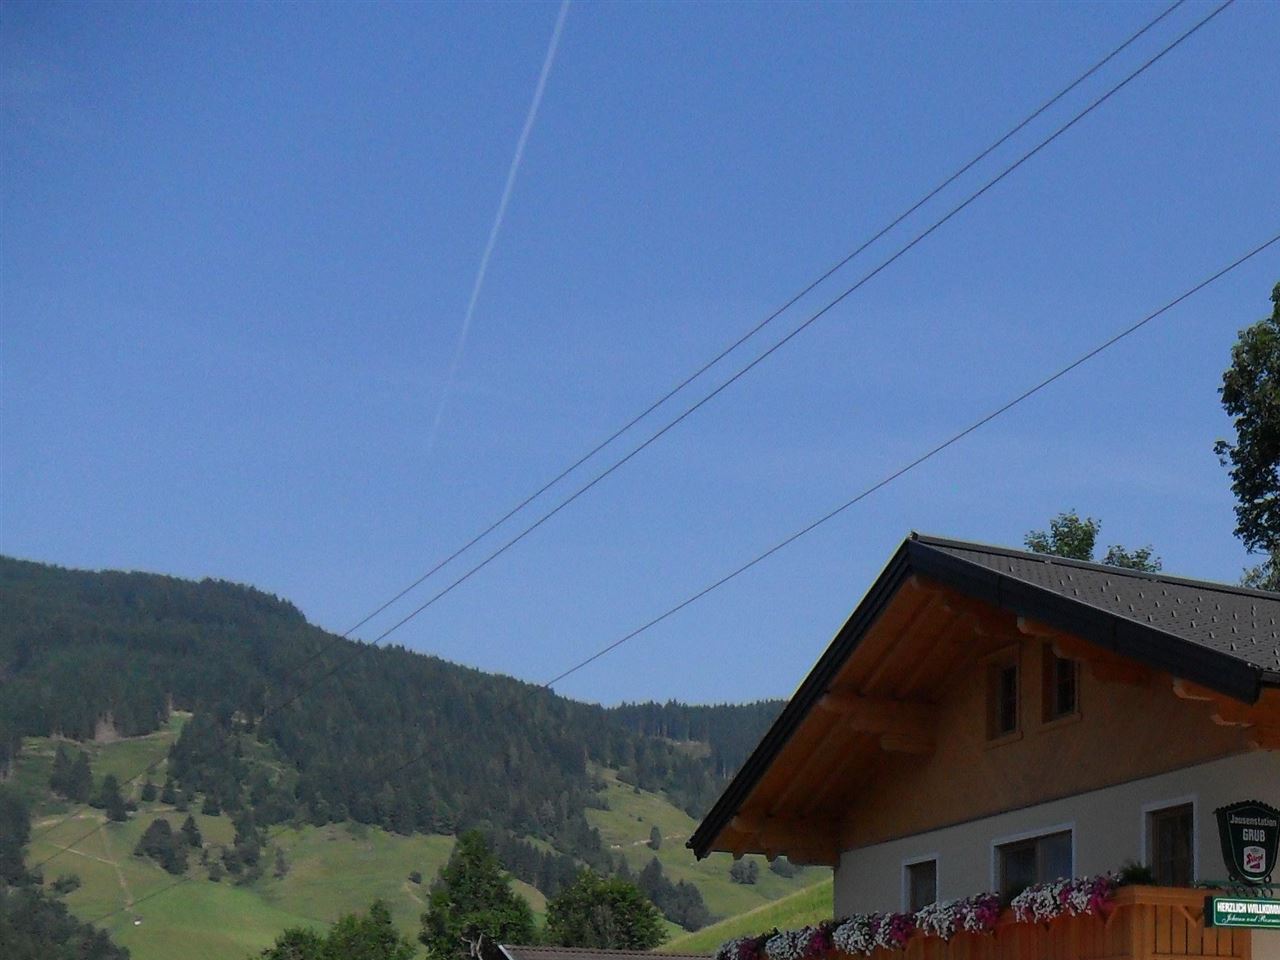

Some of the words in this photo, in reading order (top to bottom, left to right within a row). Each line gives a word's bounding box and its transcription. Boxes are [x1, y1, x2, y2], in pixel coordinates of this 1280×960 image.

[1230, 814, 1277, 827] Jausenstation
[1242, 828, 1266, 842] GRUB
[1216, 902, 1246, 913] HERZLICH
